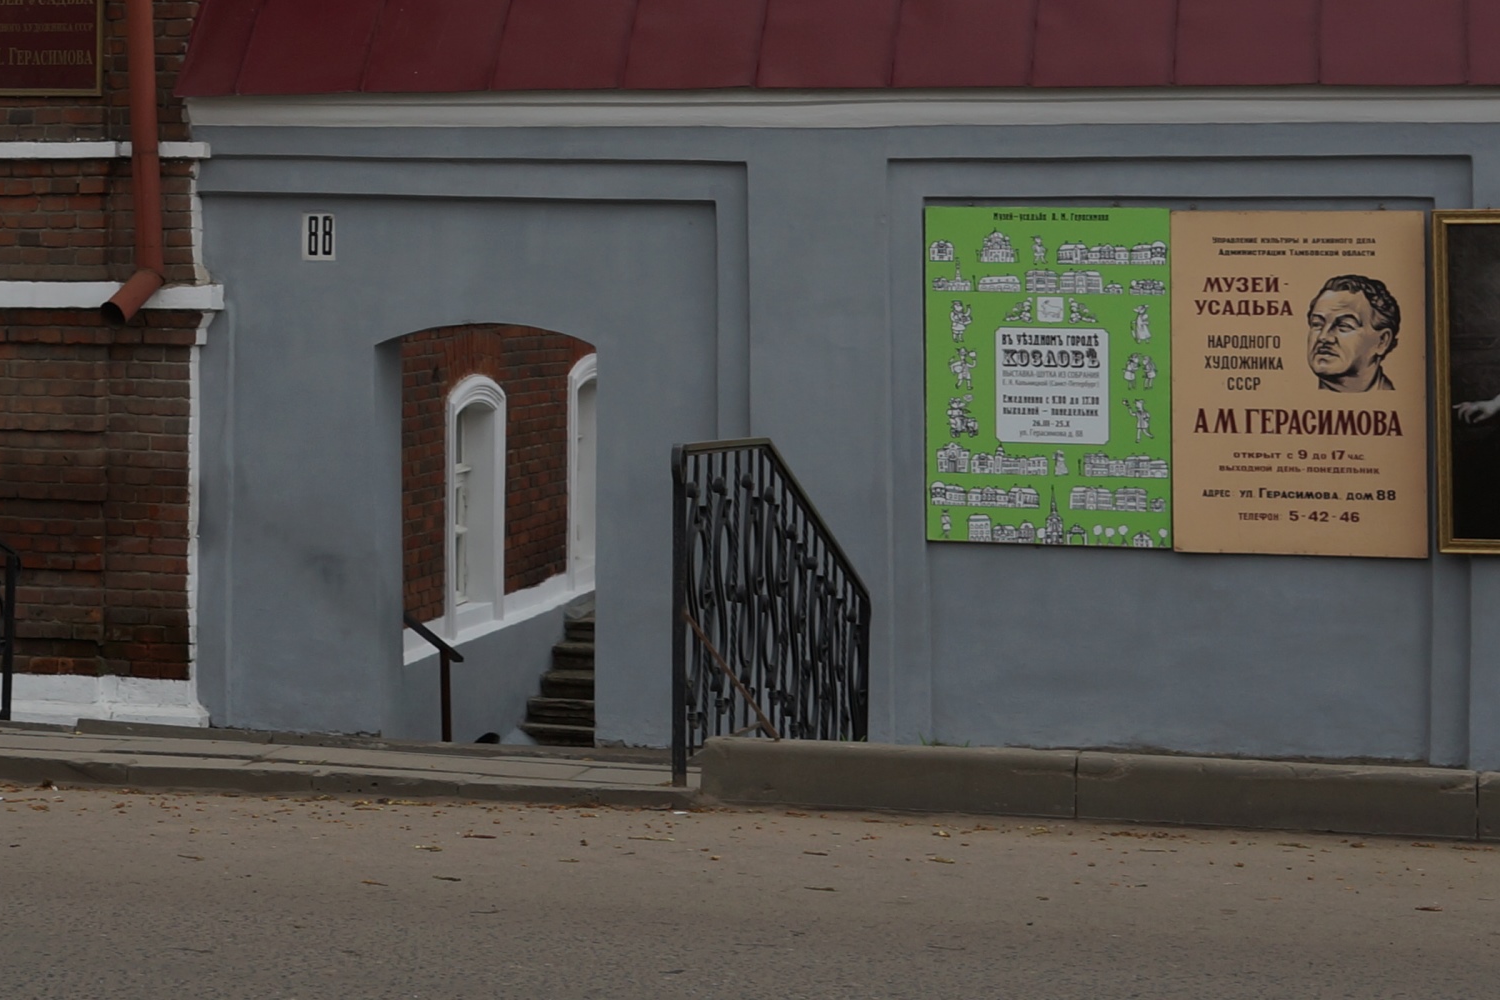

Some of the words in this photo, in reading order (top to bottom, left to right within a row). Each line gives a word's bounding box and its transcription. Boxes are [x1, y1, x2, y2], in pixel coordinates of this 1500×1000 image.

[74, 23, 93, 33] СССР
[308, 215, 332, 256] 88
[1195, 300, 1294, 316] УСАДЬБА
[1207, 335, 1281, 349] НАРОДНОГО
[1204, 355, 1284, 370] ХУДОЖНИКА
[1227, 377, 1261, 391] СССР
[1245, 409, 1403, 436] ГЕРАСИМОВА
[1298, 450, 1308, 460] 9
[1331, 450, 1346, 460] 17
[1346, 492, 1374, 501] ДОМ
[1376, 490, 1396, 501] 88
